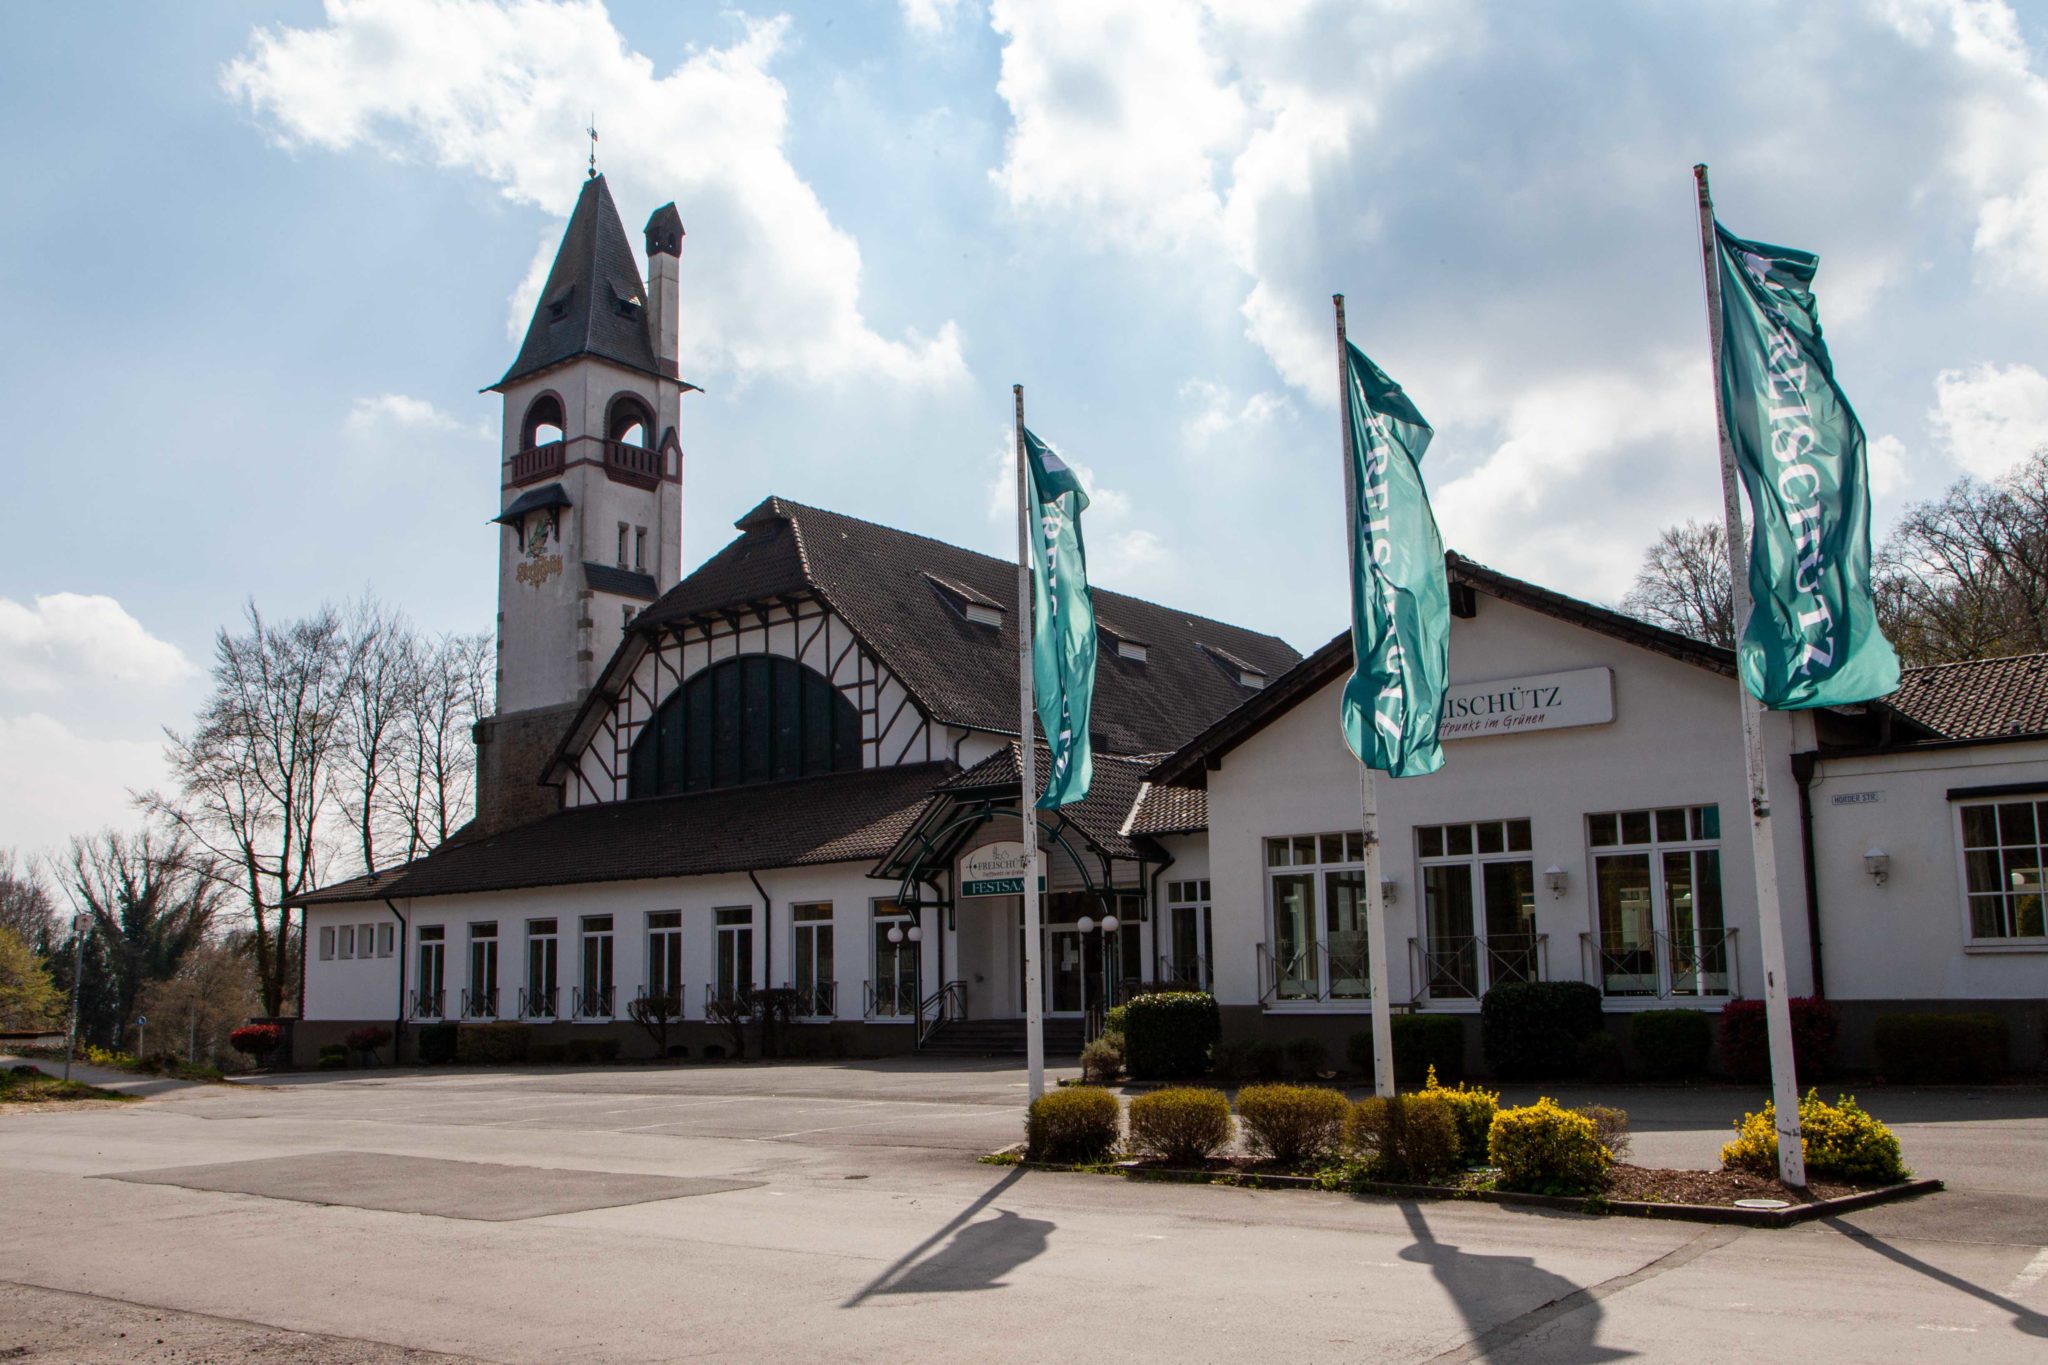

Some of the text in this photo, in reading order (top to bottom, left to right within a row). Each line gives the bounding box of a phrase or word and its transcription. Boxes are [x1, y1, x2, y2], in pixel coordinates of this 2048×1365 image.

[1442, 686, 1562, 719] ISCHÜTZ
[1484, 718, 1498, 729] im
[1503, 713, 1546, 729] Grünen
[972, 881, 1025, 894] FESTSAA
